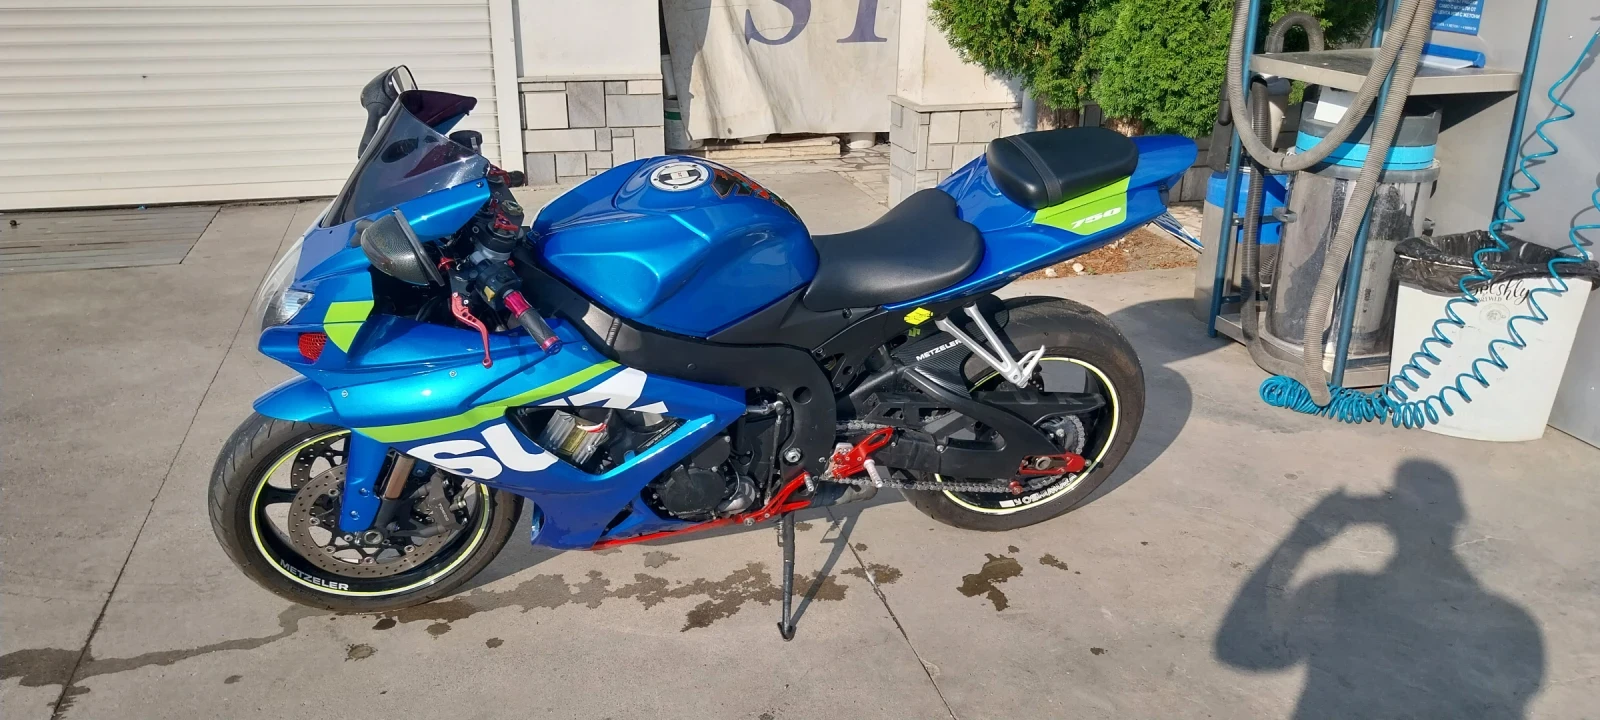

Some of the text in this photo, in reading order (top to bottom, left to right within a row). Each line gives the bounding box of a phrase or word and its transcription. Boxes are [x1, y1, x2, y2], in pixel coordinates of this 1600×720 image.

[1071, 207, 1122, 229] 750
[915, 338, 962, 361] METZELER
[279, 557, 350, 591] METZELER
